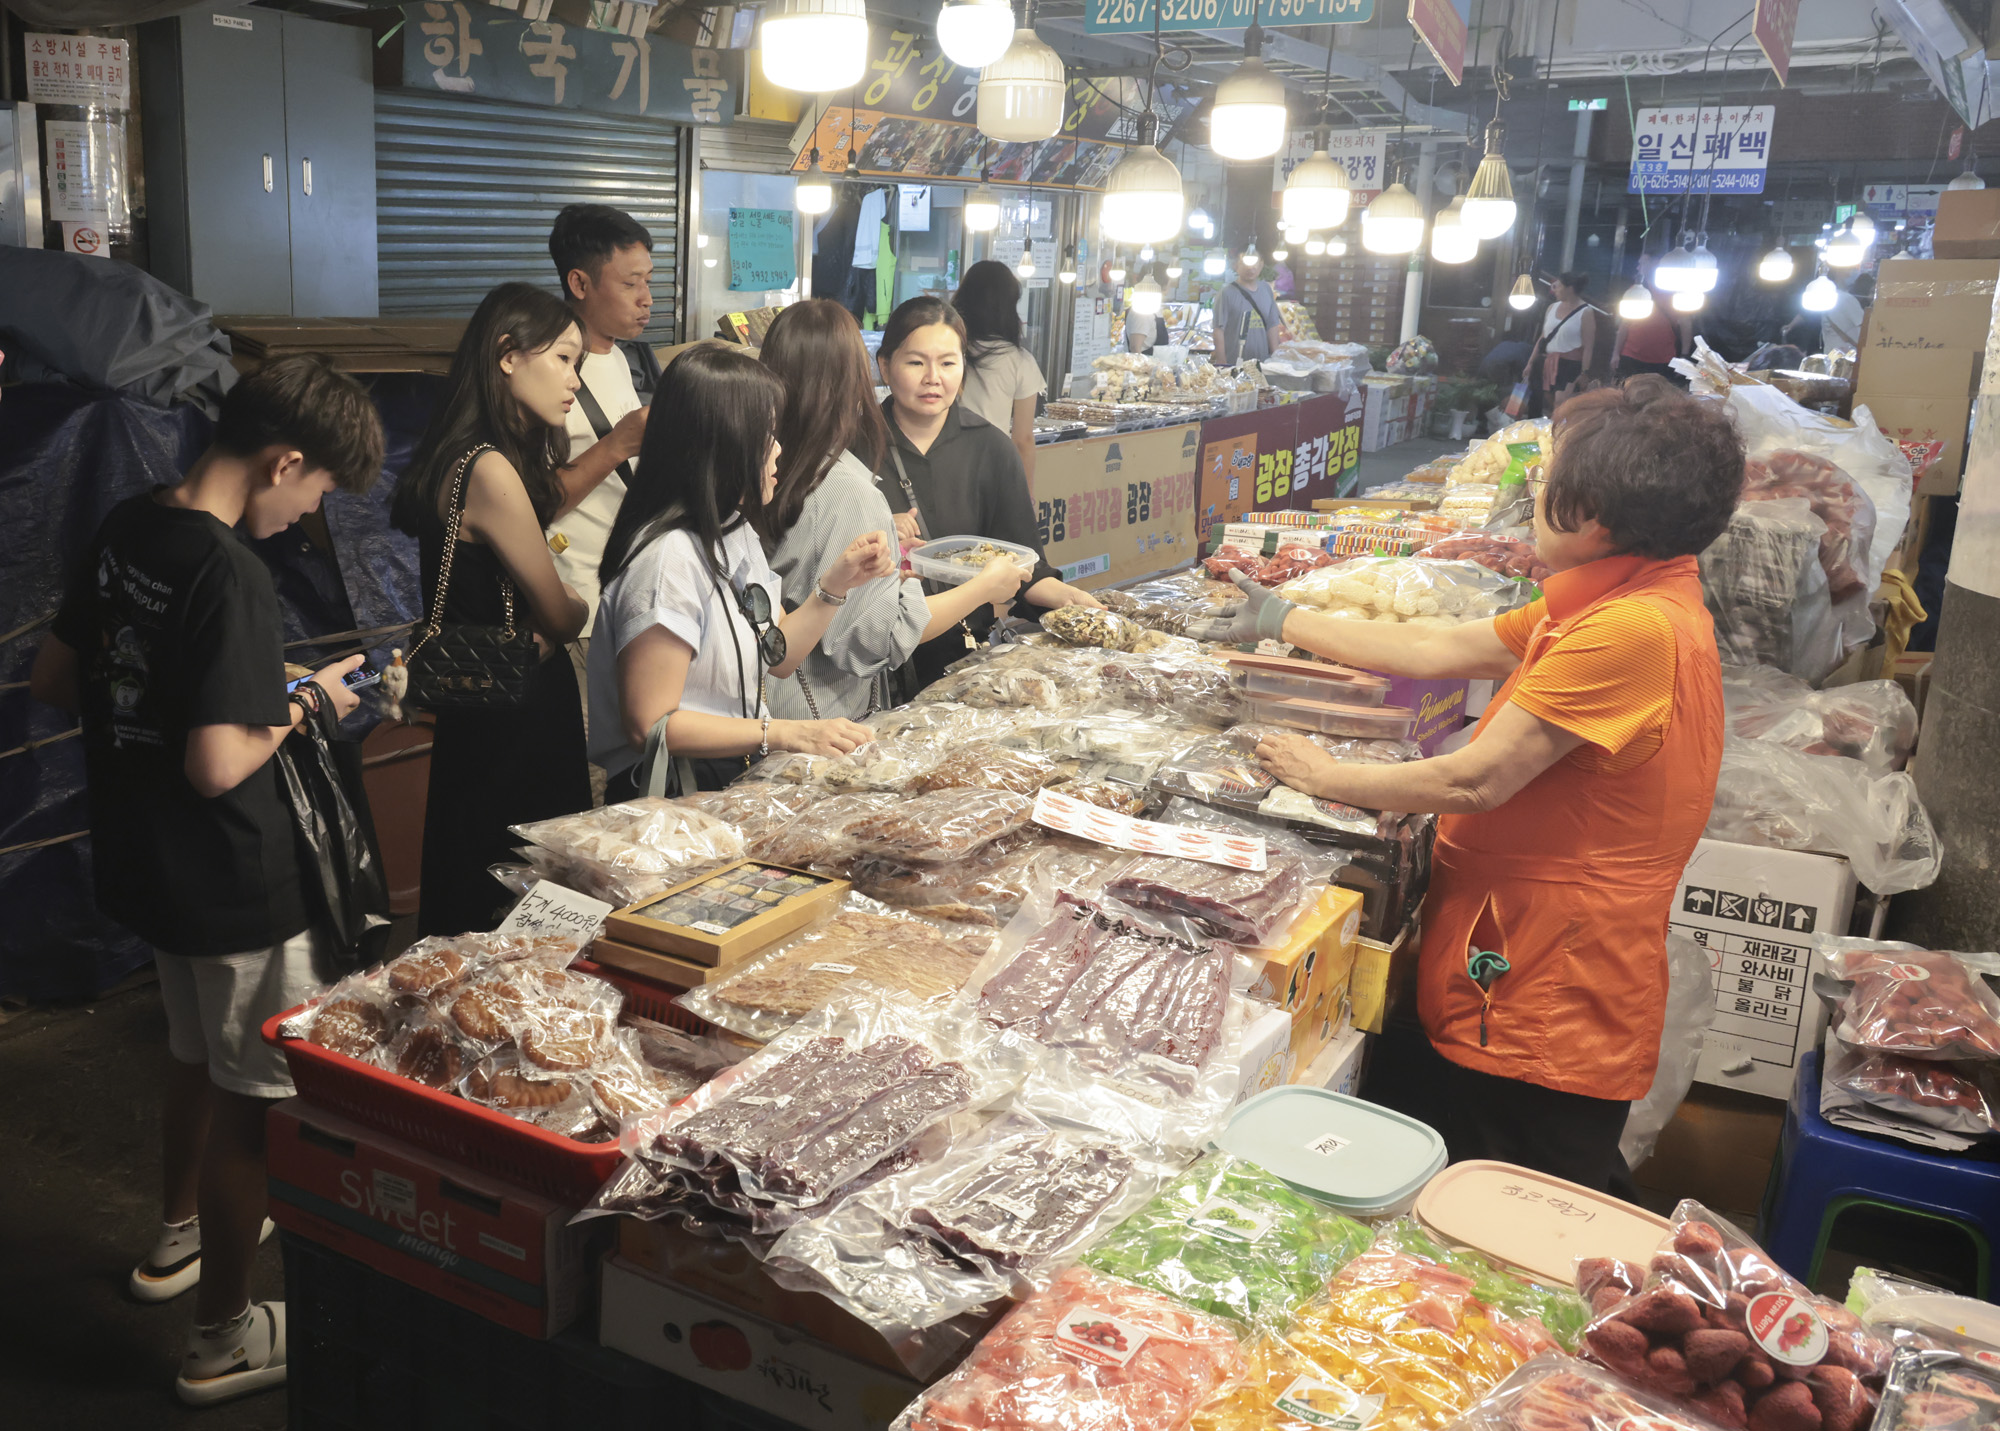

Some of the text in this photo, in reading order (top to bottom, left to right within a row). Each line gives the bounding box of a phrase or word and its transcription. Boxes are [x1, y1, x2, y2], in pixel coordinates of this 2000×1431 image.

[32, 38, 122, 61] 소방시설 주변
[32, 60, 123, 84] 물건 적치 및 매대 금지
[1637, 131, 1767, 160] 일신폐백
[151, 580, 173, 595] chan
[1412, 688, 1464, 737] Primavera
[550, 905, 599, 933] 4000원
[1742, 940, 1798, 964] 재래김
[1740, 959, 1794, 983] 와사비
[1737, 978, 1793, 1001] 불 닭
[1734, 998, 1788, 1021] 올리브
[398, 1231, 461, 1269] mango
[1754, 1296, 1788, 1335] Straw Berry
[1282, 1402, 1356, 1430] Apple Mngo
